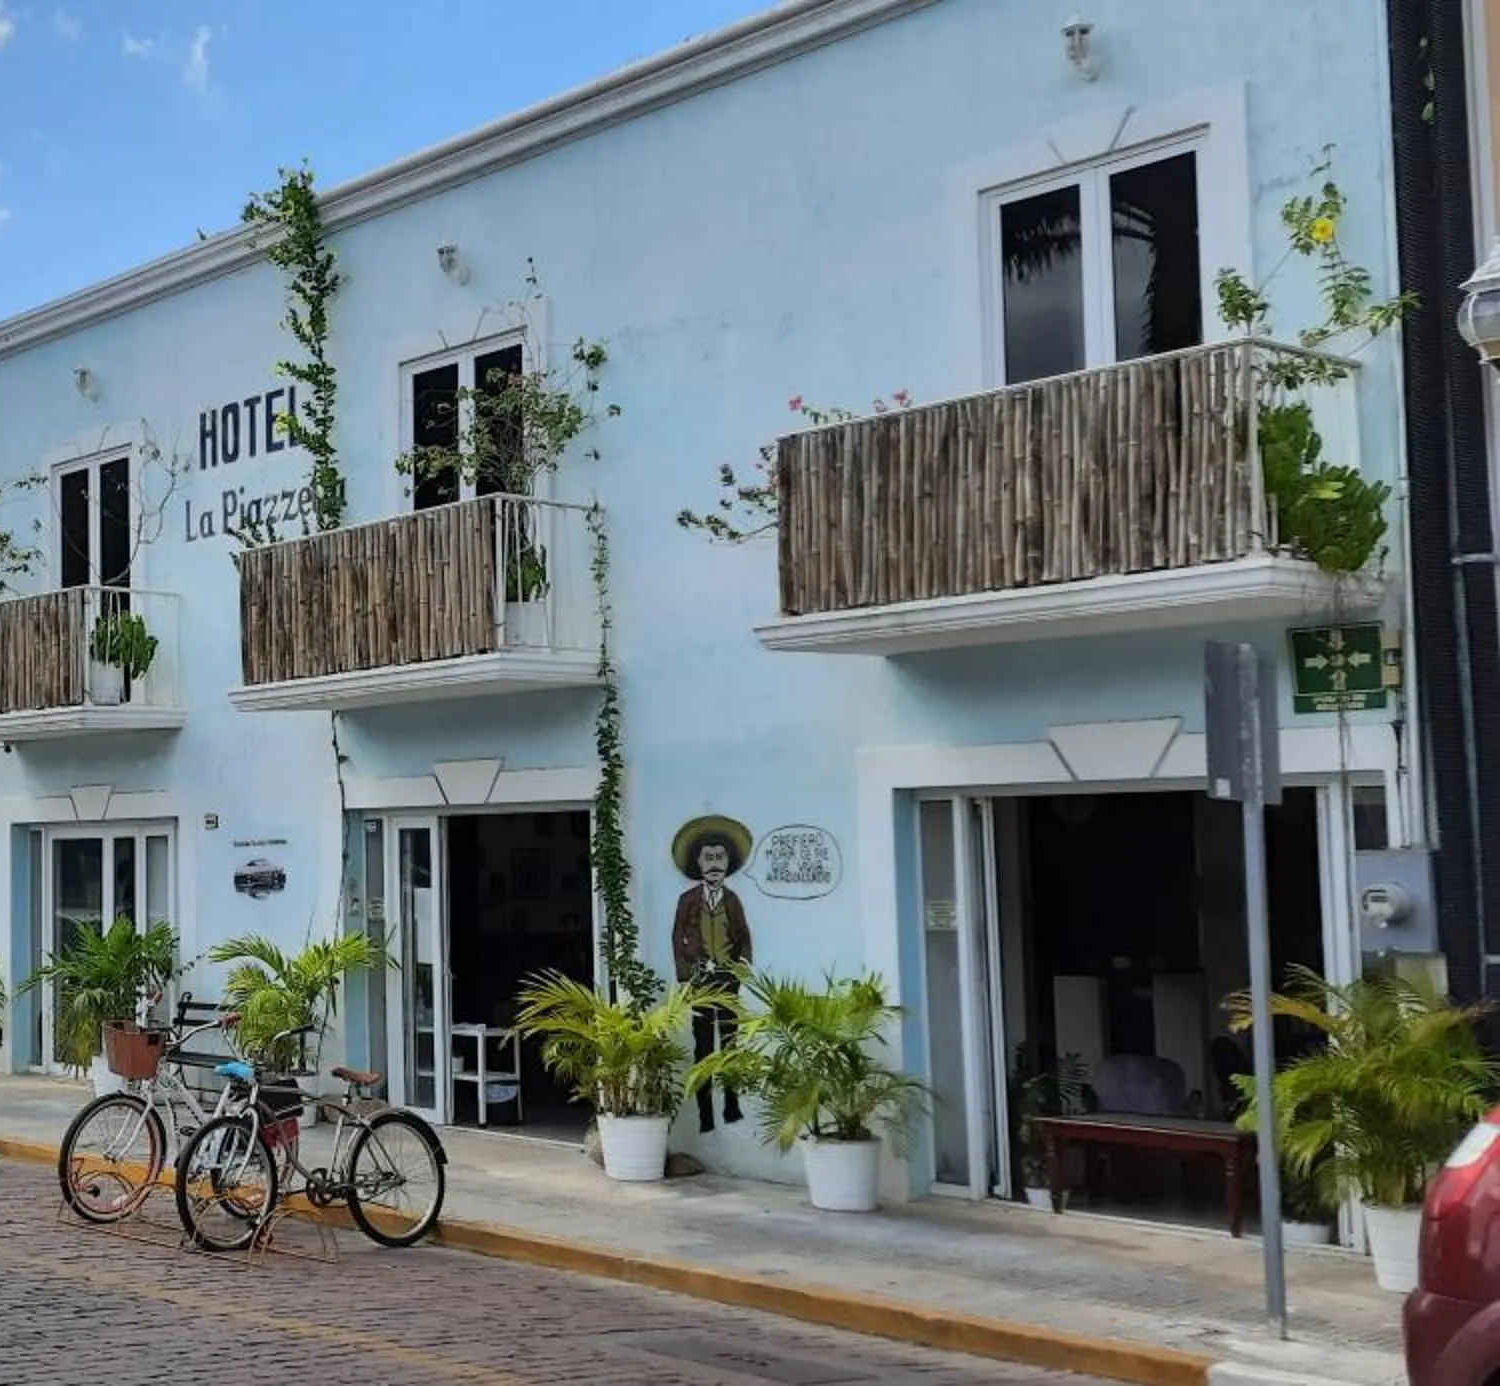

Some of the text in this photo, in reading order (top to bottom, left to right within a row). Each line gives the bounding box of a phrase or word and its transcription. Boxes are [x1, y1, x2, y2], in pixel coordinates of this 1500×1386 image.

[199, 385, 306, 470] HOTEL
[185, 478, 348, 542] La Piazze
